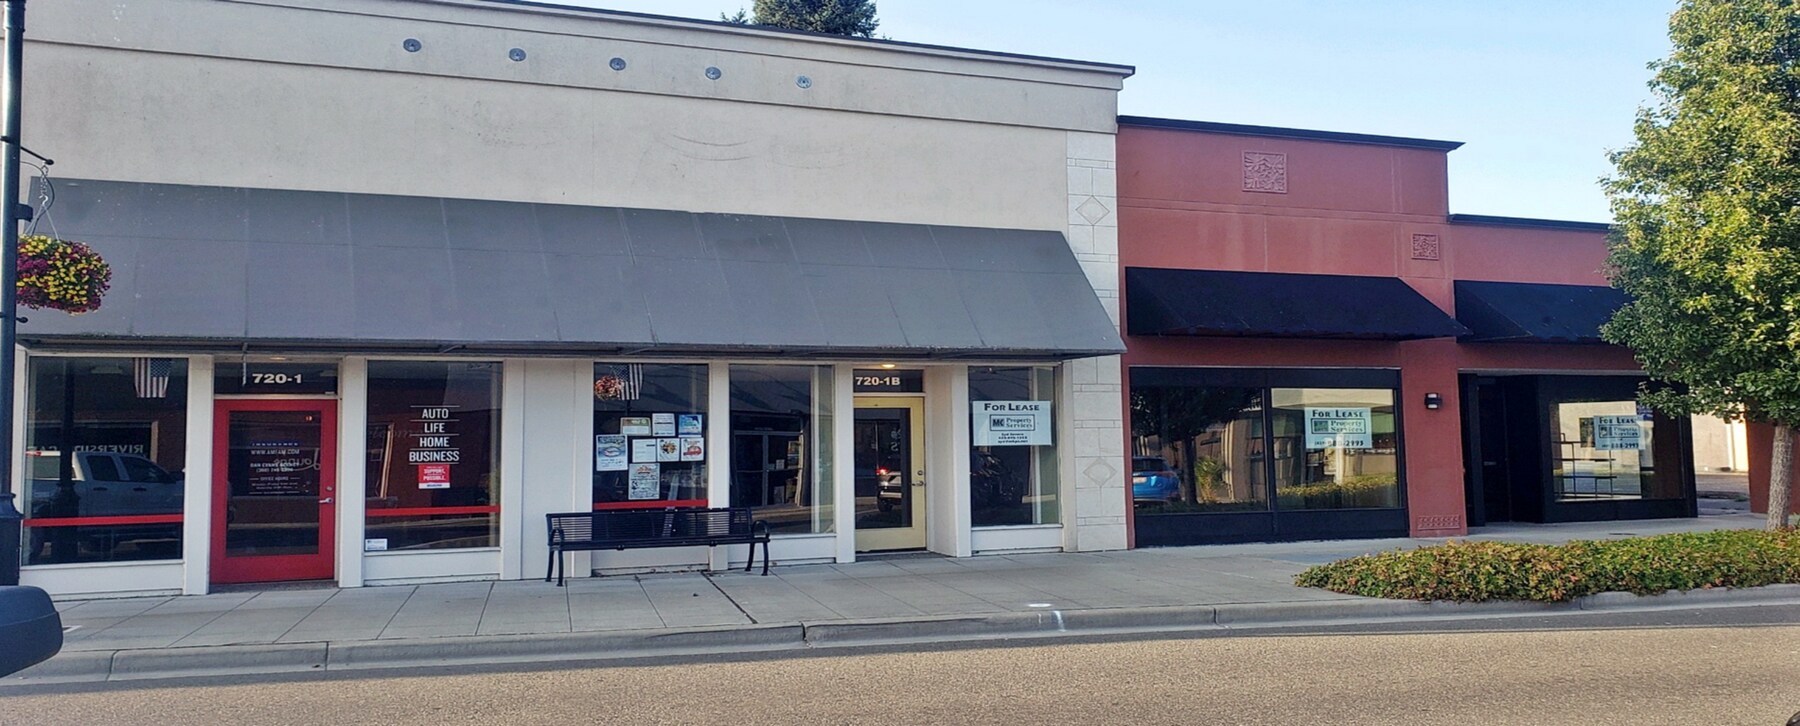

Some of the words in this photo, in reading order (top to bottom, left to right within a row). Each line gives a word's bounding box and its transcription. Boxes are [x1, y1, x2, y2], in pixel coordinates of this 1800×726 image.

[252, 373, 301, 384] 720-1
[855, 376, 900, 386] 720-1B
[984, 403, 1006, 411] FOR
[1008, 403, 1040, 411] LEASE
[422, 408, 449, 419] AUTO
[424, 423, 445, 433] LIFE
[420, 437, 450, 447] HOME
[409, 451, 459, 462] BUSINESS
